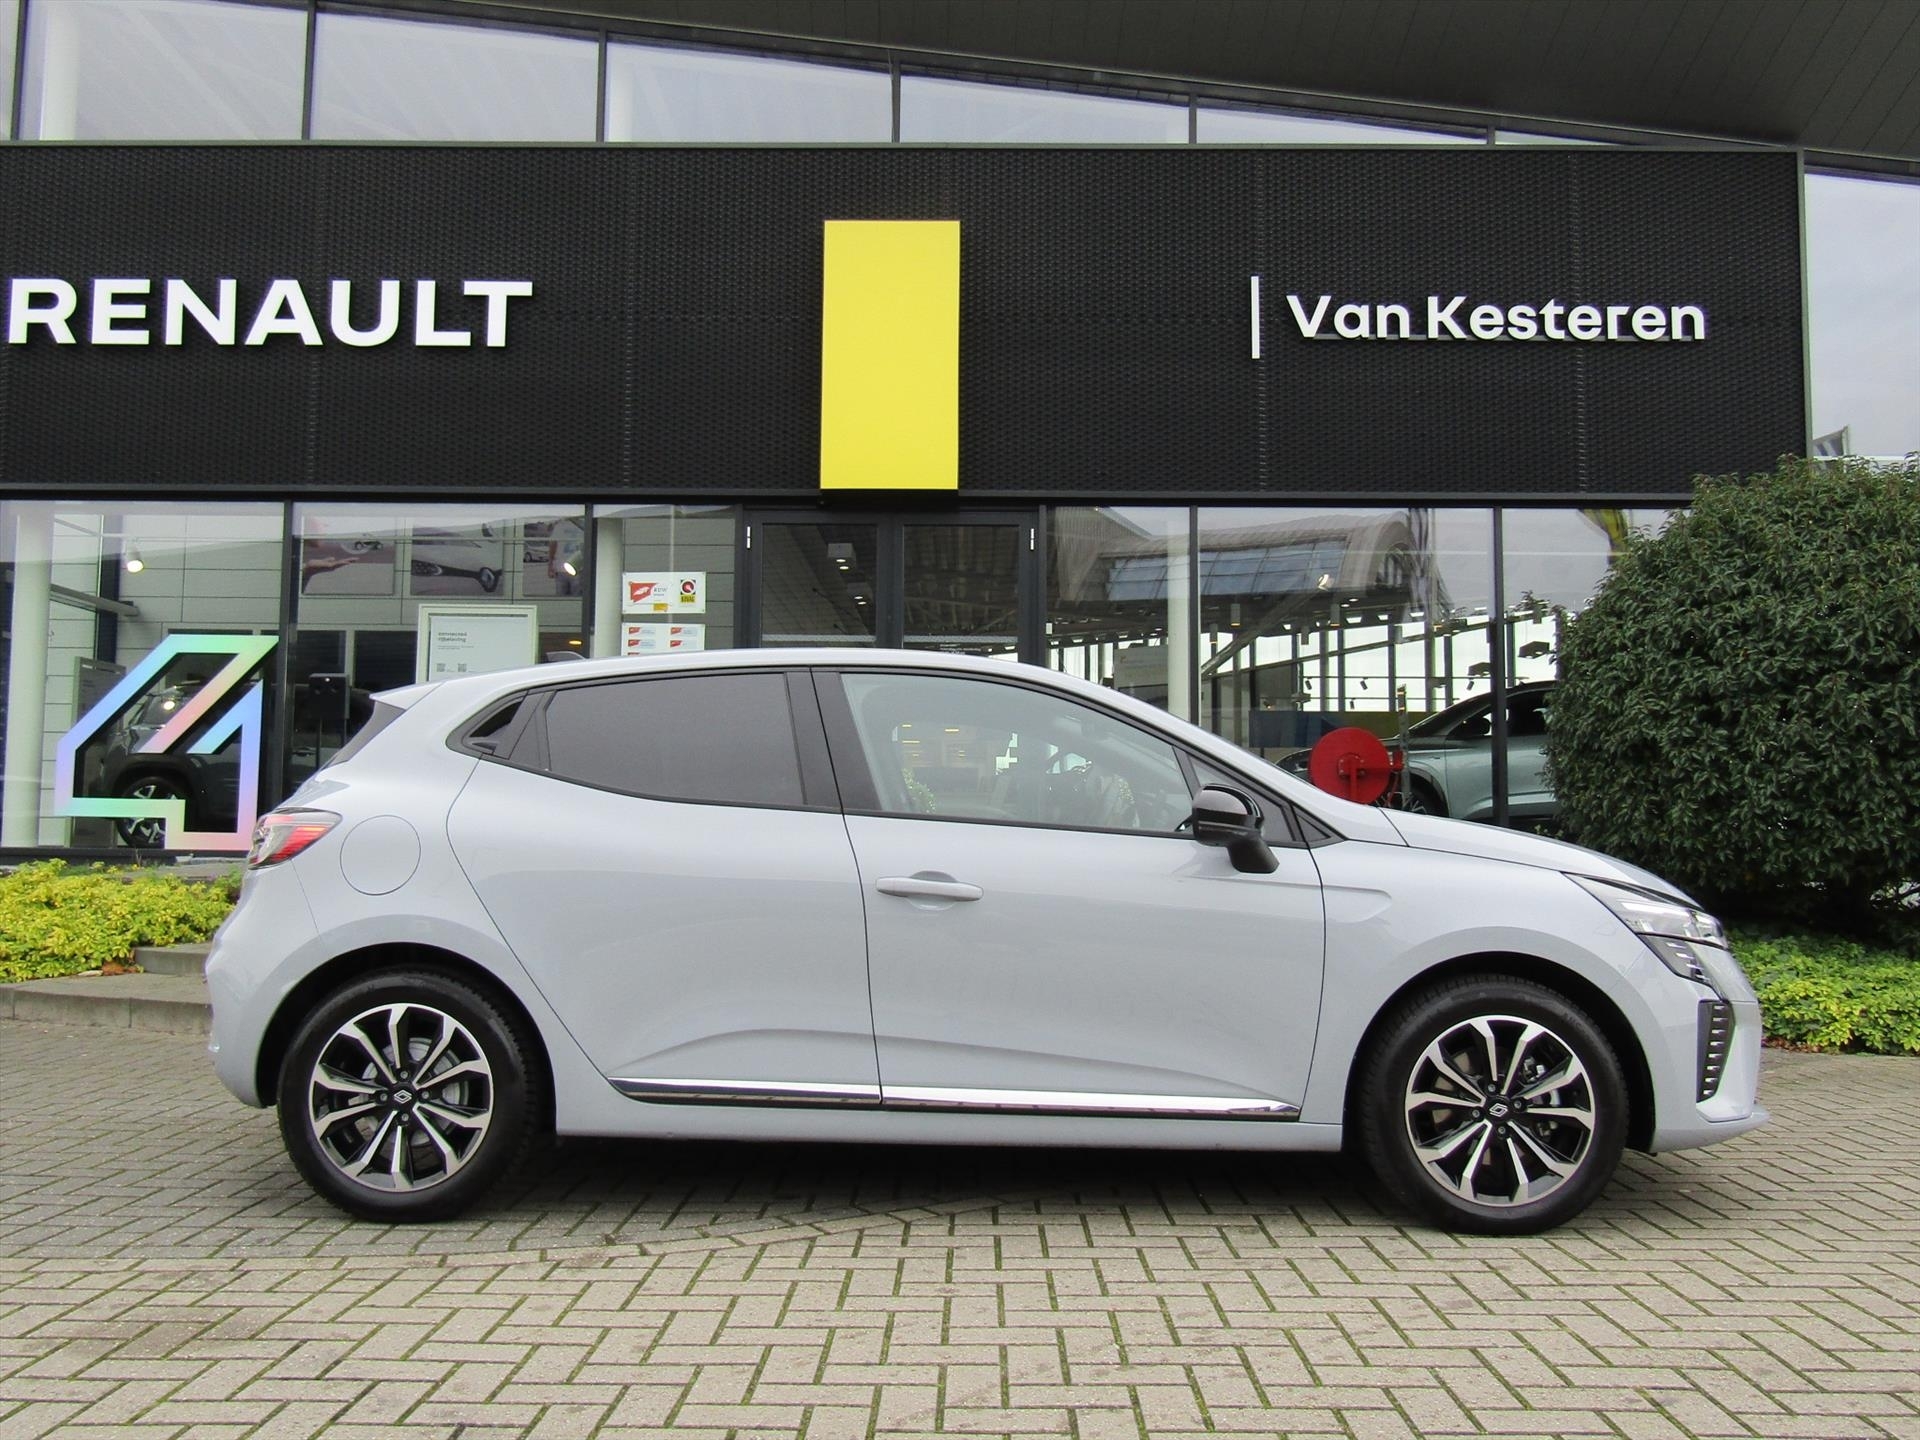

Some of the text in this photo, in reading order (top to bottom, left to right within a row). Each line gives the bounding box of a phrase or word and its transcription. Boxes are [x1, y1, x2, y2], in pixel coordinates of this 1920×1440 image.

[8, 278, 533, 347] RENAULT
[1286, 295, 1706, 341] Van Kesteren
